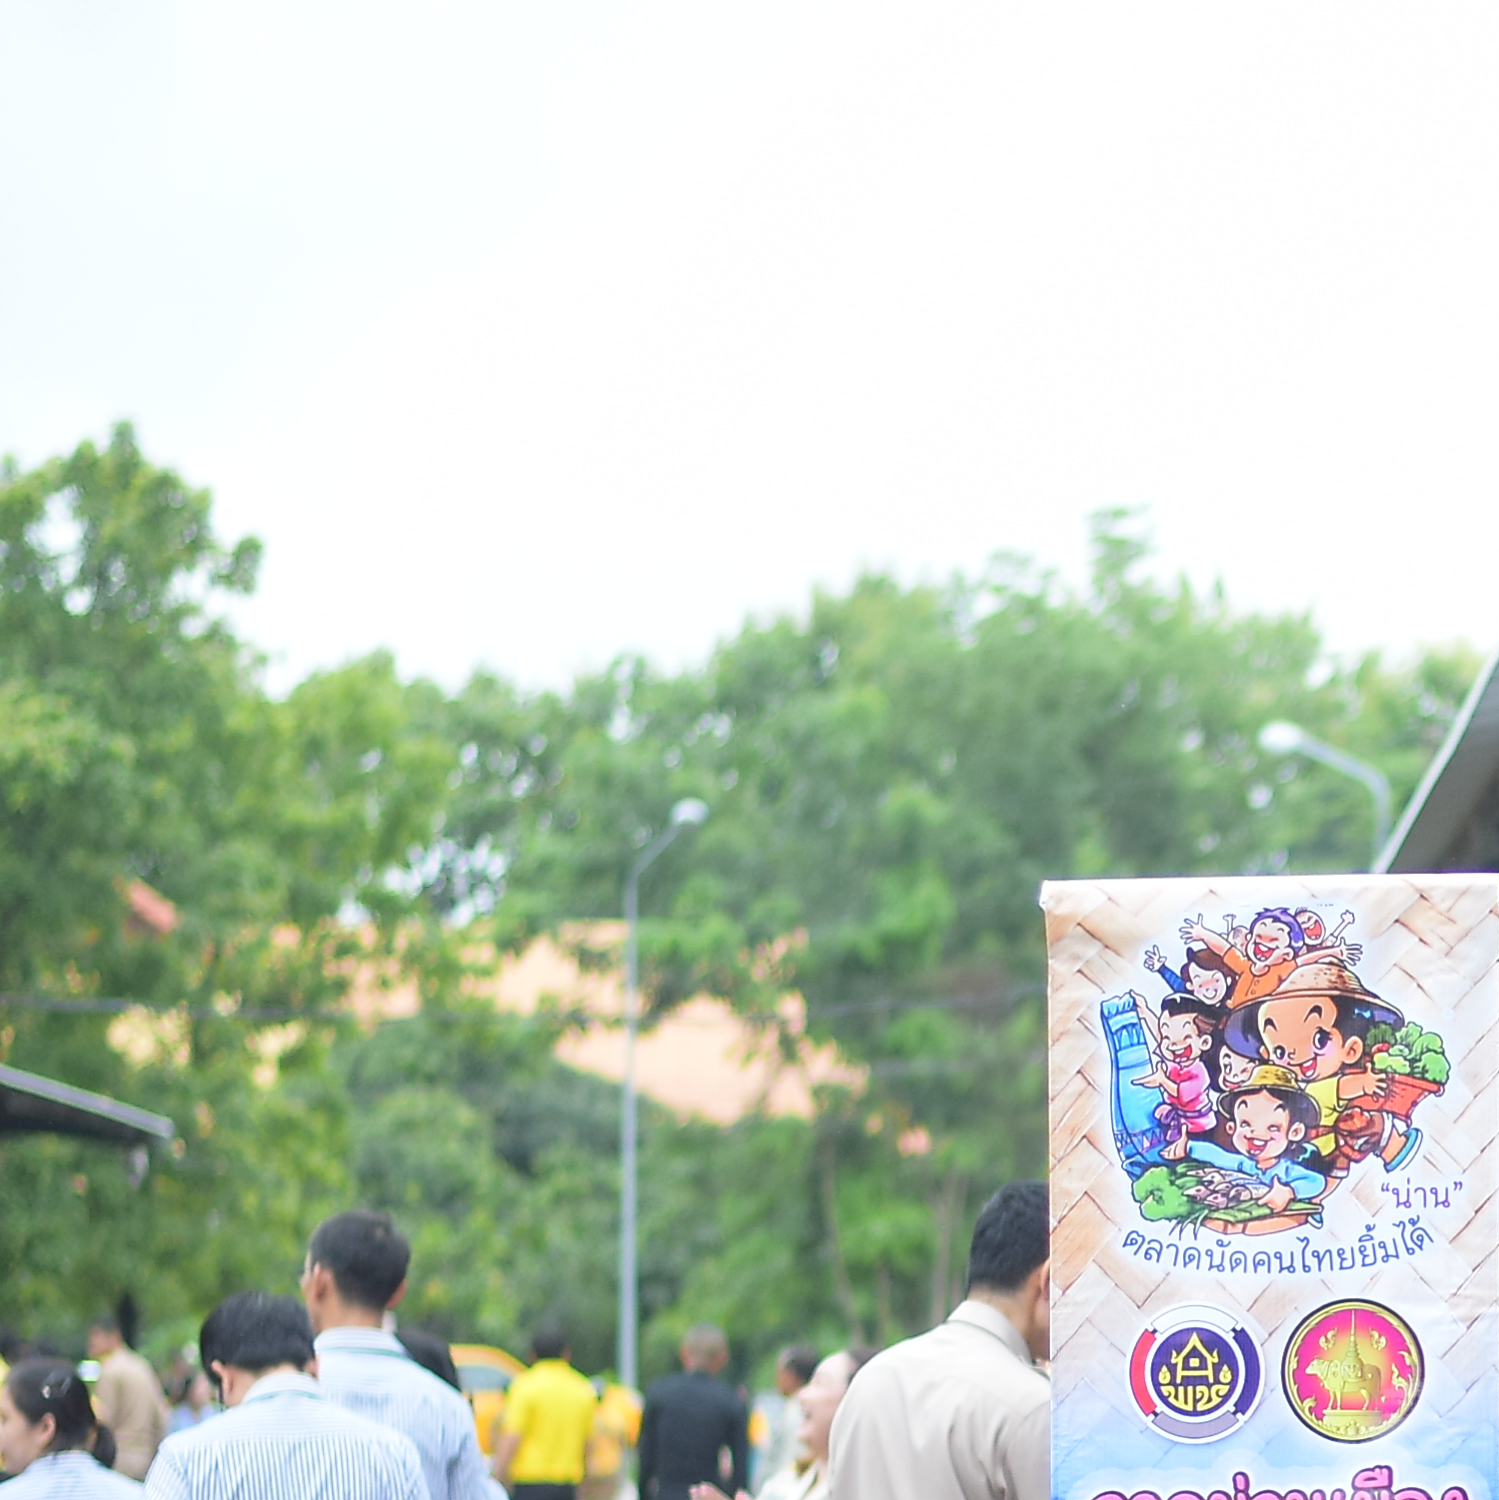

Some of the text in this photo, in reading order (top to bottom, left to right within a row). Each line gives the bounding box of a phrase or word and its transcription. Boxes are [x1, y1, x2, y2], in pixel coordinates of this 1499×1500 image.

[1122, 1214, 1434, 1276] ตลาดนัดคนไทยยิ้มได้
